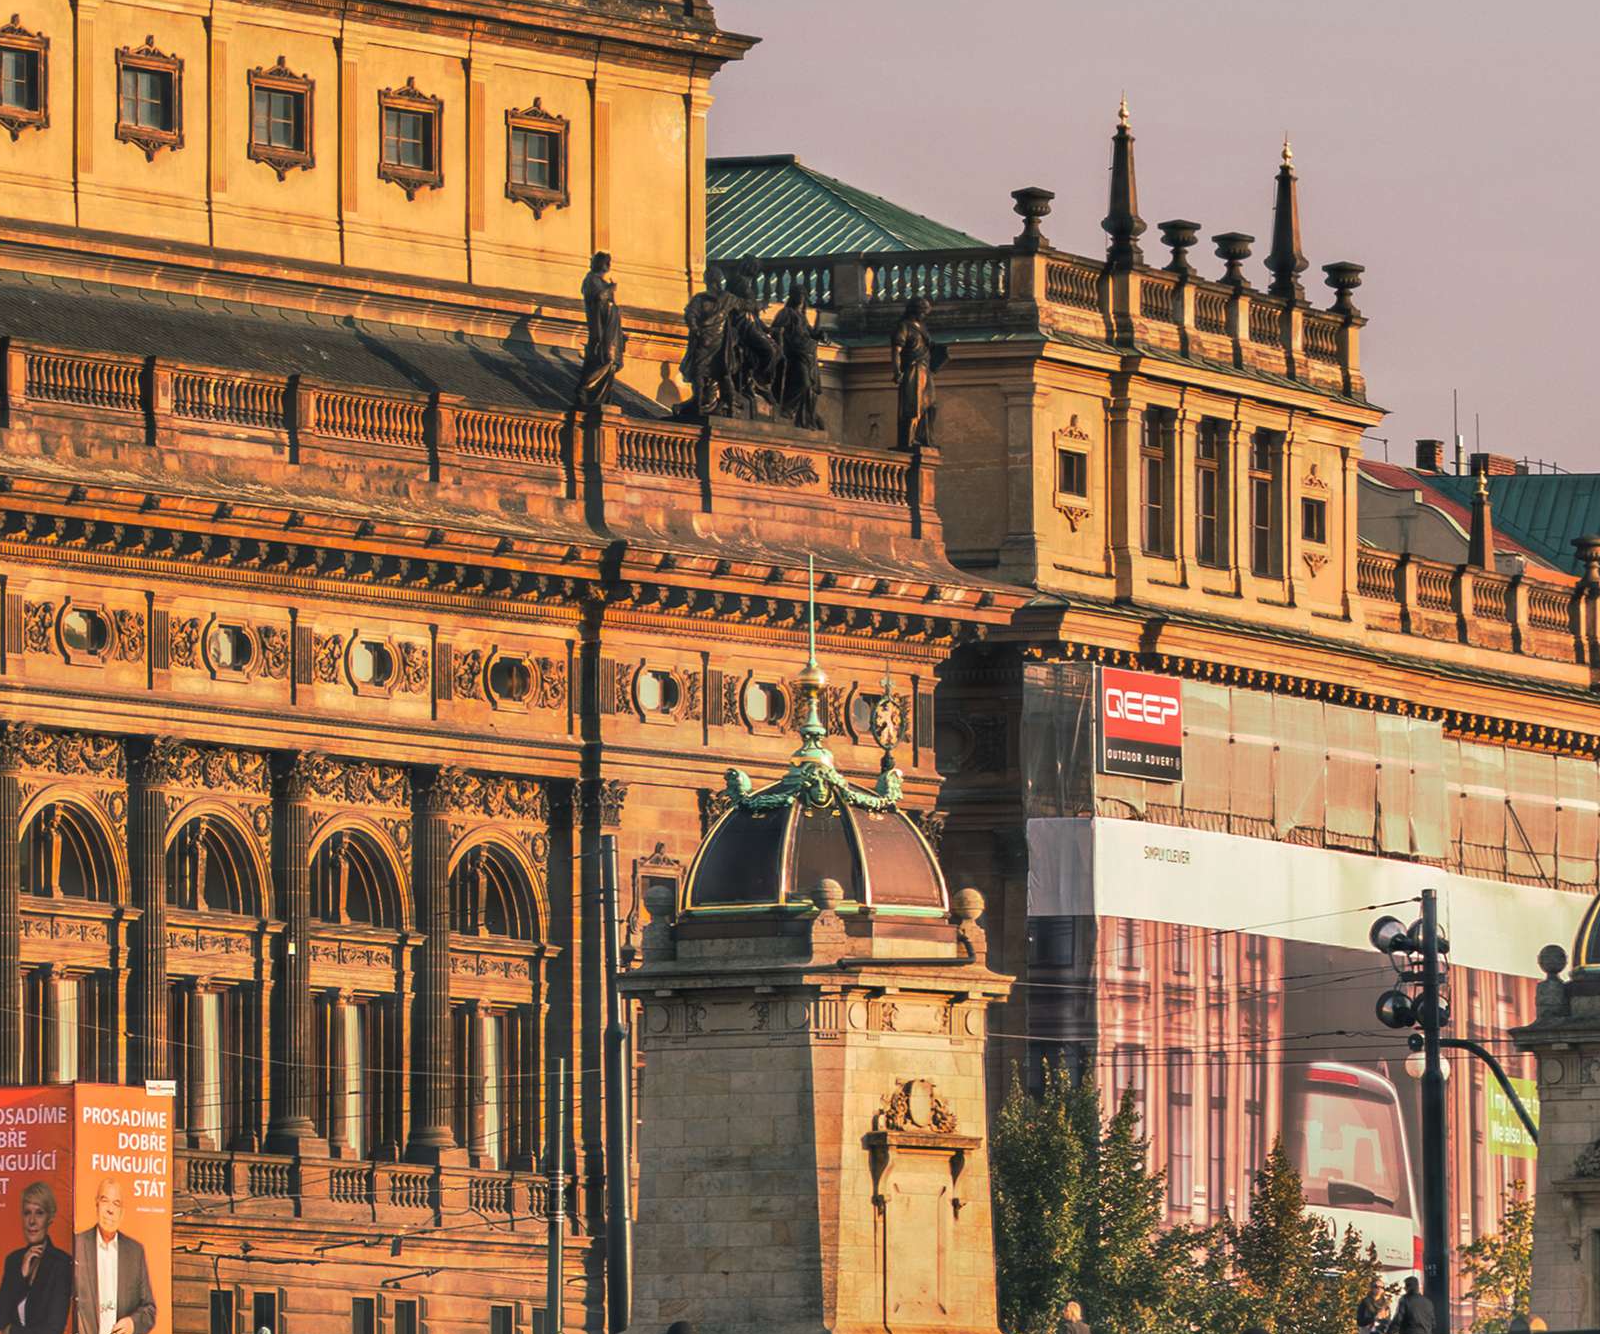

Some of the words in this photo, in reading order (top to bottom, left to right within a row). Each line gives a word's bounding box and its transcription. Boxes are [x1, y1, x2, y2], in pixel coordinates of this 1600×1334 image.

[1105, 688, 1179, 725] QEEP
[1107, 748, 1142, 763] OUTDOOR
[1144, 845, 1165, 861] SIMPLY
[1166, 848, 1191, 864] CLEVER
[83, 1106, 168, 1129] PROSADÍME
[118, 1131, 167, 1152] DOBŘE
[92, 1153, 167, 1176] FUNGUJÍCÍ
[134, 1176, 166, 1198] STÁT
